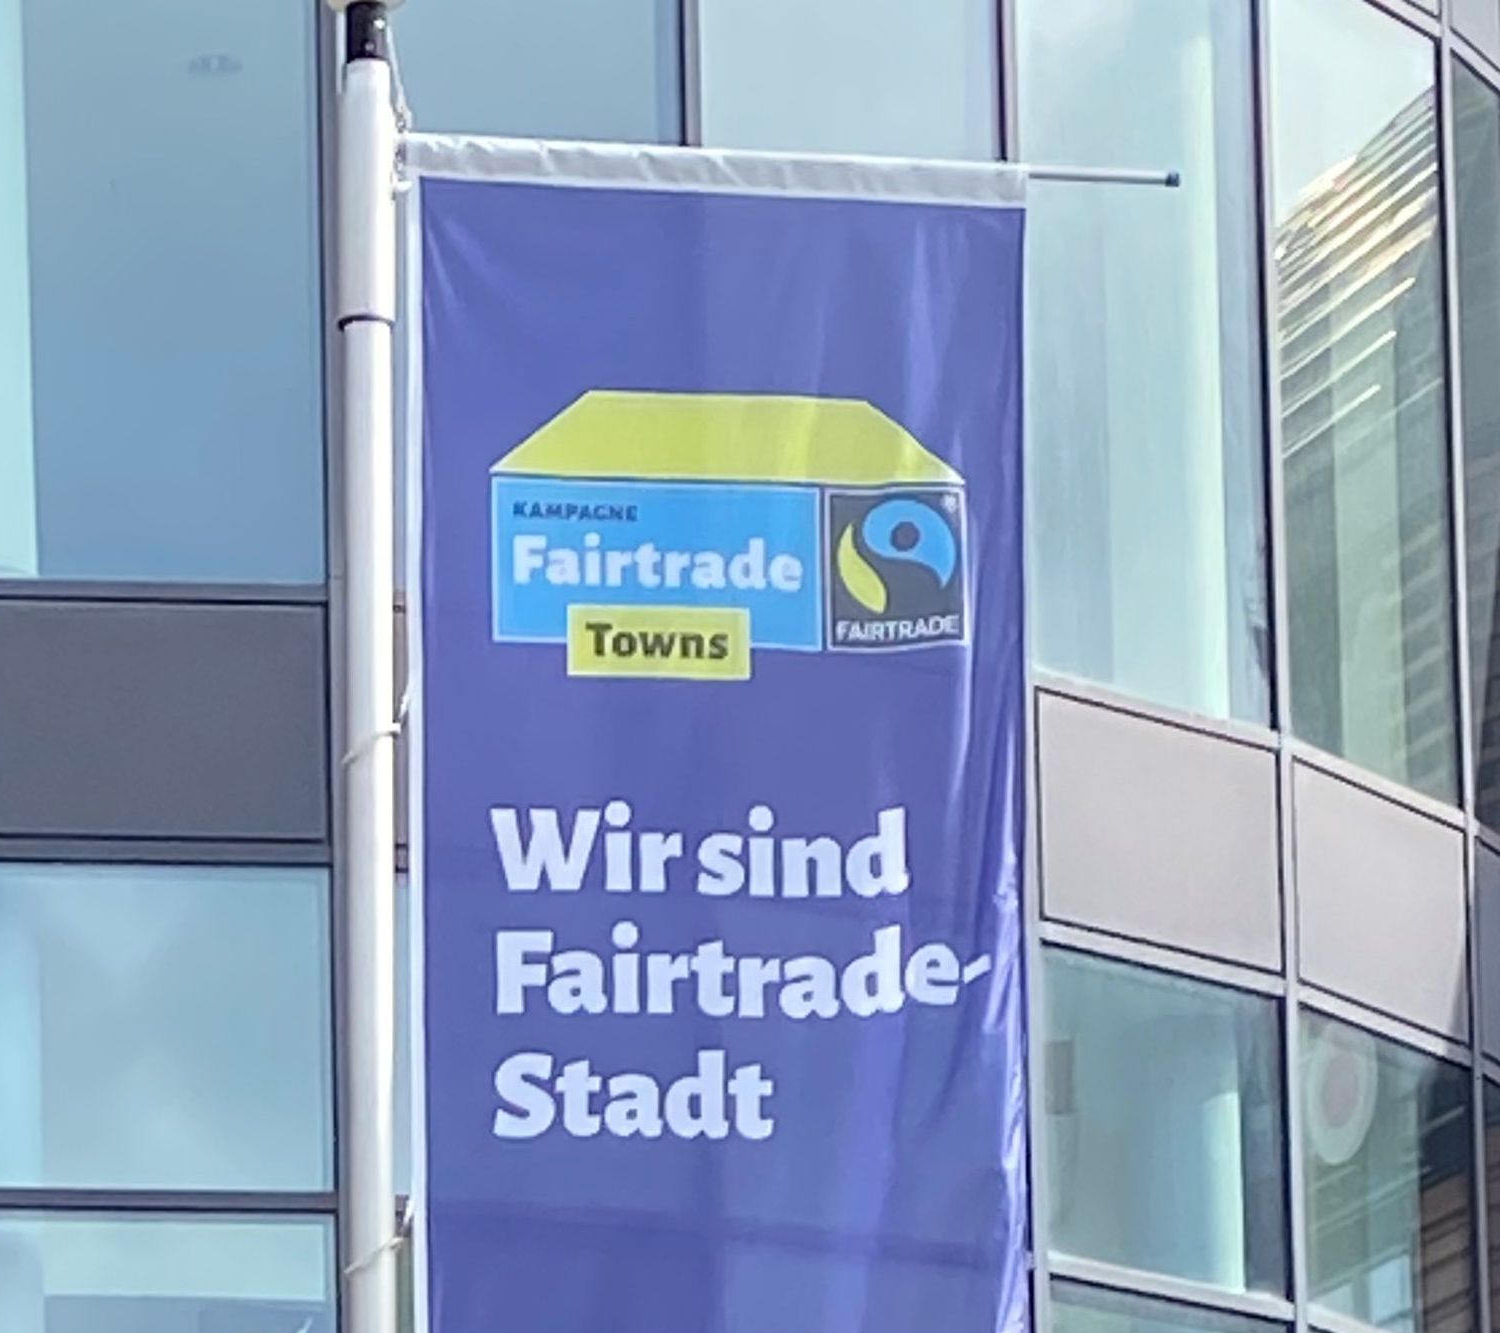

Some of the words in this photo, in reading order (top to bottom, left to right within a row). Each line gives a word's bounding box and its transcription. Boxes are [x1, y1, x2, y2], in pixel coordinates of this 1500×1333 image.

[512, 500, 639, 522] KAMPAGNE
[511, 532, 803, 591] Fairtrade
[585, 621, 730, 660] Towns
[835, 613, 960, 642] FAIRTRADE
[489, 799, 684, 893] Wir
[696, 804, 910, 898] sind
[495, 920, 992, 1019] Fairtrade-
[492, 1049, 775, 1141] Stadt
